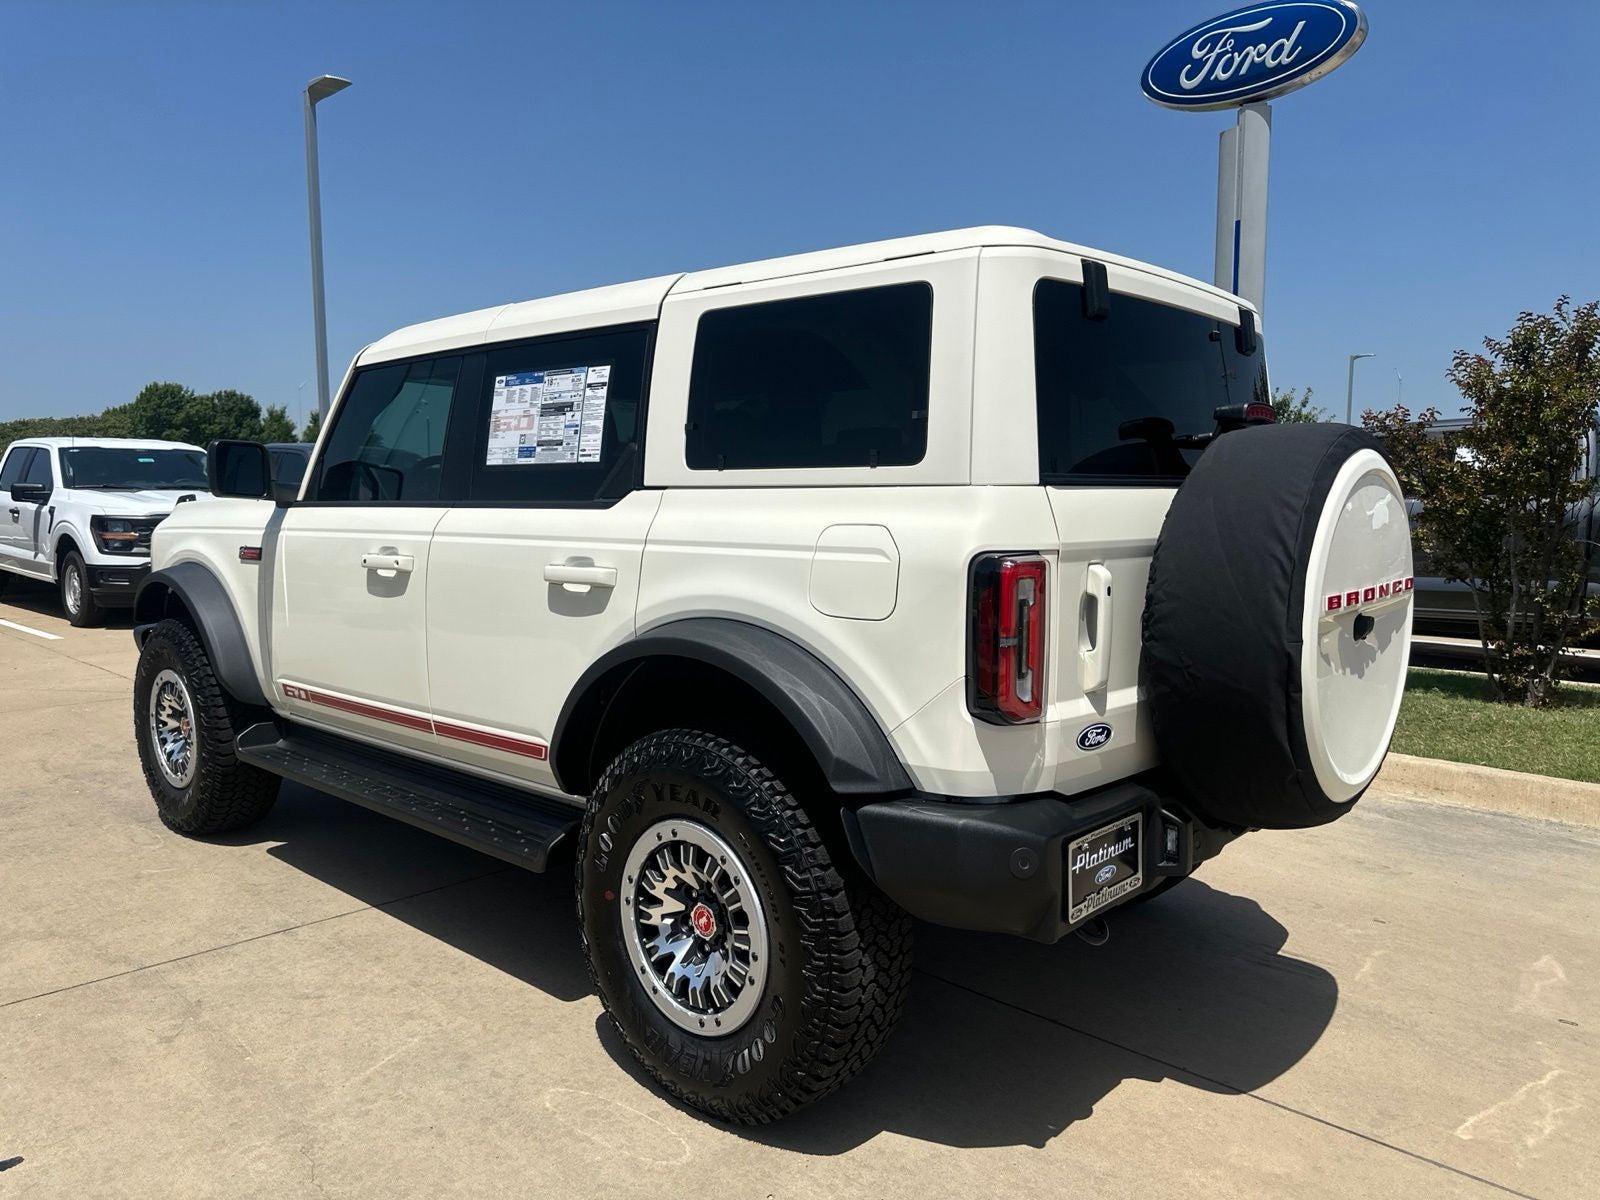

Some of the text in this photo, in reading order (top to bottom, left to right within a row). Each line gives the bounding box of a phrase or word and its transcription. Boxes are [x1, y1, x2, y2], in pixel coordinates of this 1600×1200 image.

[1179, 17, 1307, 90] Ford
[1327, 577, 1414, 611] BRONCO
[282, 683, 311, 703] 60
[1085, 728, 1106, 746] Ford
[1071, 836, 1135, 875] Platinum
[1097, 867, 1114, 882] Ford
[1086, 884, 1128, 912] Platinum
